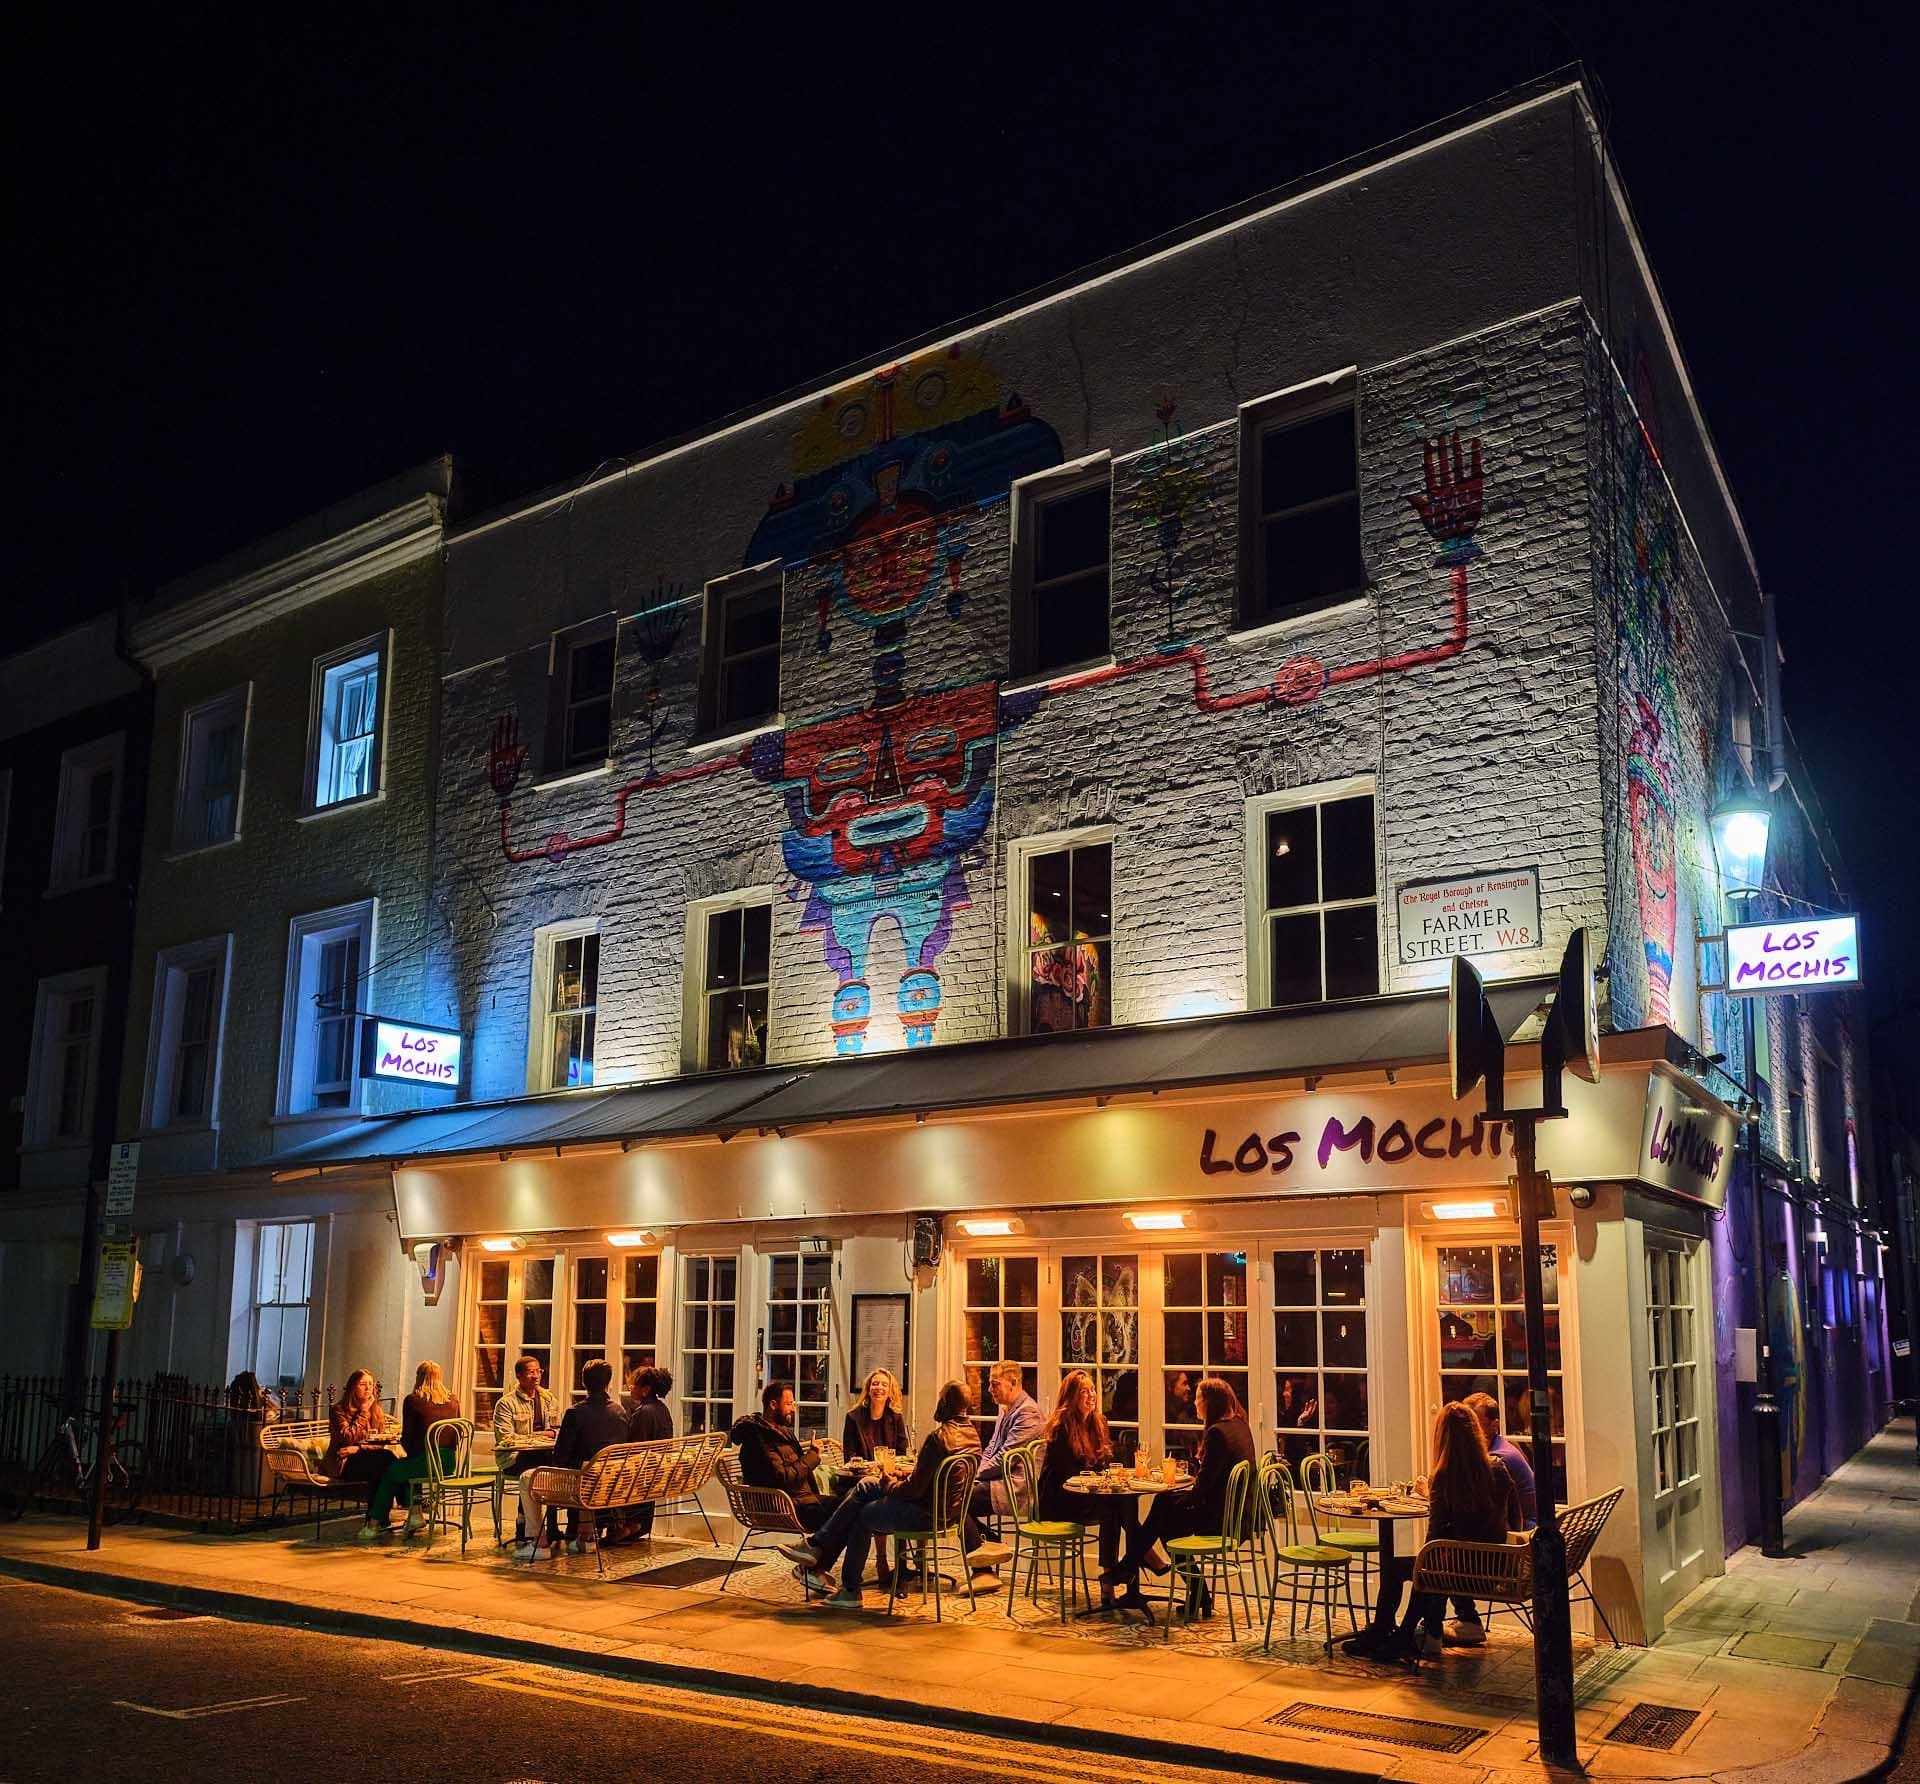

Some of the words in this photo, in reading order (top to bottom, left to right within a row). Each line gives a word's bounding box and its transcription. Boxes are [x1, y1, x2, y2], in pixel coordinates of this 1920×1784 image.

[1403, 895, 1417, 904] The
[1419, 891, 1440, 903] Royal
[1443, 886, 1473, 898] Borough
[1477, 883, 1485, 893] of
[1487, 878, 1529, 891] Kensington
[1442, 902, 1456, 912] and
[1460, 899, 1489, 910] Chelsea
[1423, 908, 1511, 935] FARMER
[1763, 931, 1820, 953] LOS
[1736, 956, 1850, 983] MOCHIS
[401, 1032, 439, 1053] LOS
[381, 1052, 455, 1078] MOCHIS
[1200, 1128, 1301, 1175] LOS
[1317, 1115, 1514, 1169] MOCHI
[1650, 1105, 1680, 1168] LOS
